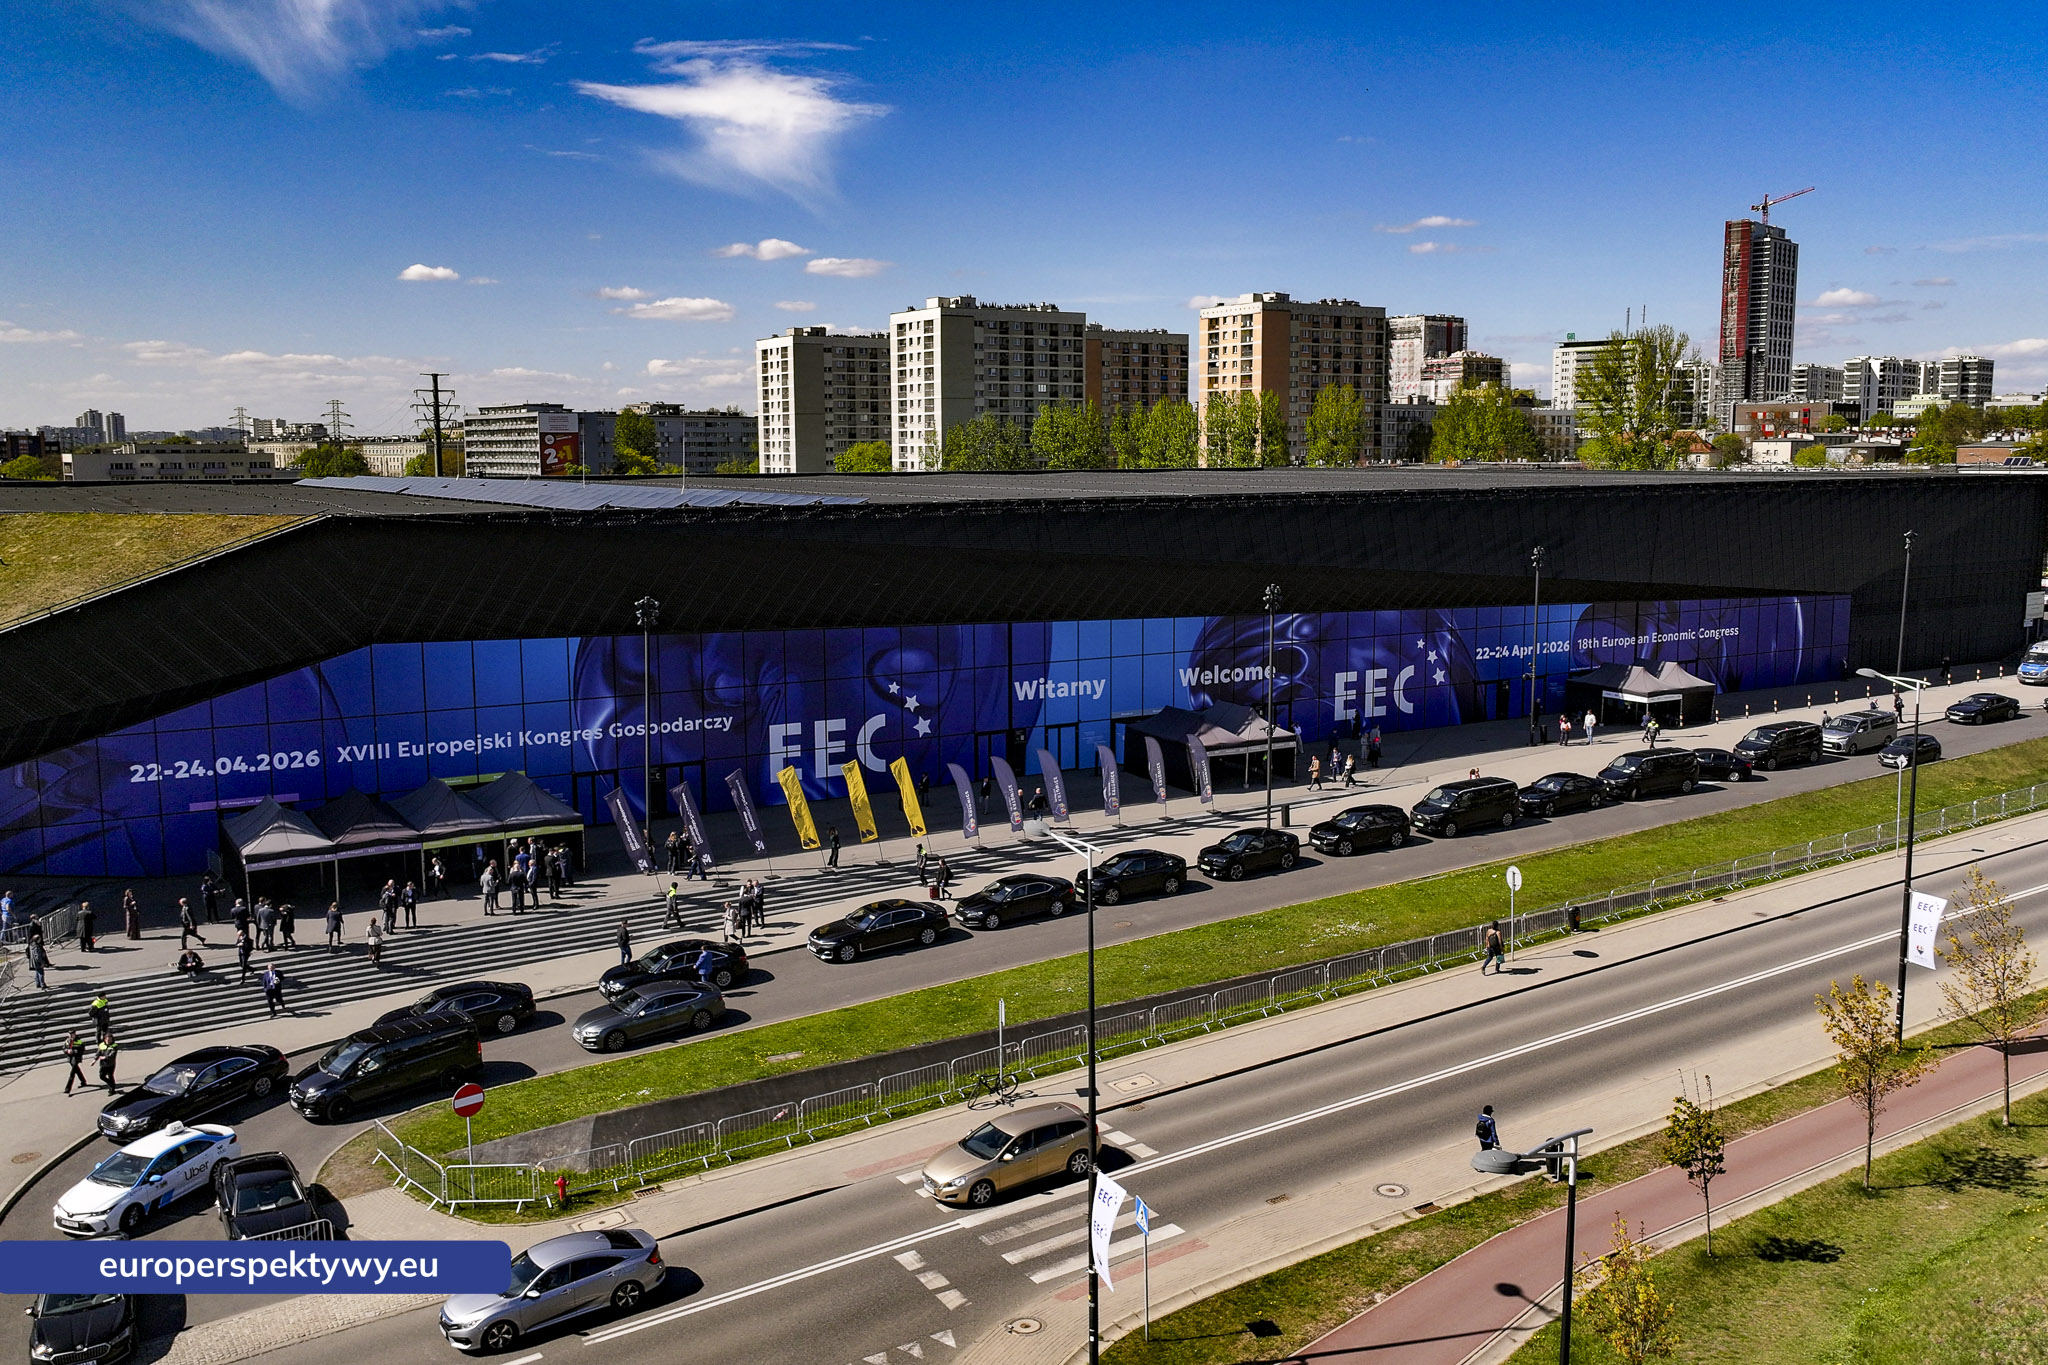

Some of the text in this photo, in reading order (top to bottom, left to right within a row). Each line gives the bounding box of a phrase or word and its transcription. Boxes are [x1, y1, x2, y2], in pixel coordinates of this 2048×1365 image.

[544, 445, 573, 465] 2+1
[1511, 642, 1540, 659] Aprl
[1542, 640, 1570, 654] 2026
[1577, 626, 1739, 650] 18th European Economic Congress
[1178, 664, 1276, 687] Welcome
[1014, 678, 1106, 701] Witamy
[1334, 664, 1414, 721] EEC
[337, 716, 733, 763] XVIII Europejski Kongres Gospodarczy
[769, 713, 886, 784] EEC
[129, 749, 321, 783] 22-24.04.2026
[1917, 901, 1934, 912] EEC
[1913, 923, 1928, 935] EEC
[184, 1160, 210, 1181] Uber
[1097, 1188, 1113, 1207] EEC
